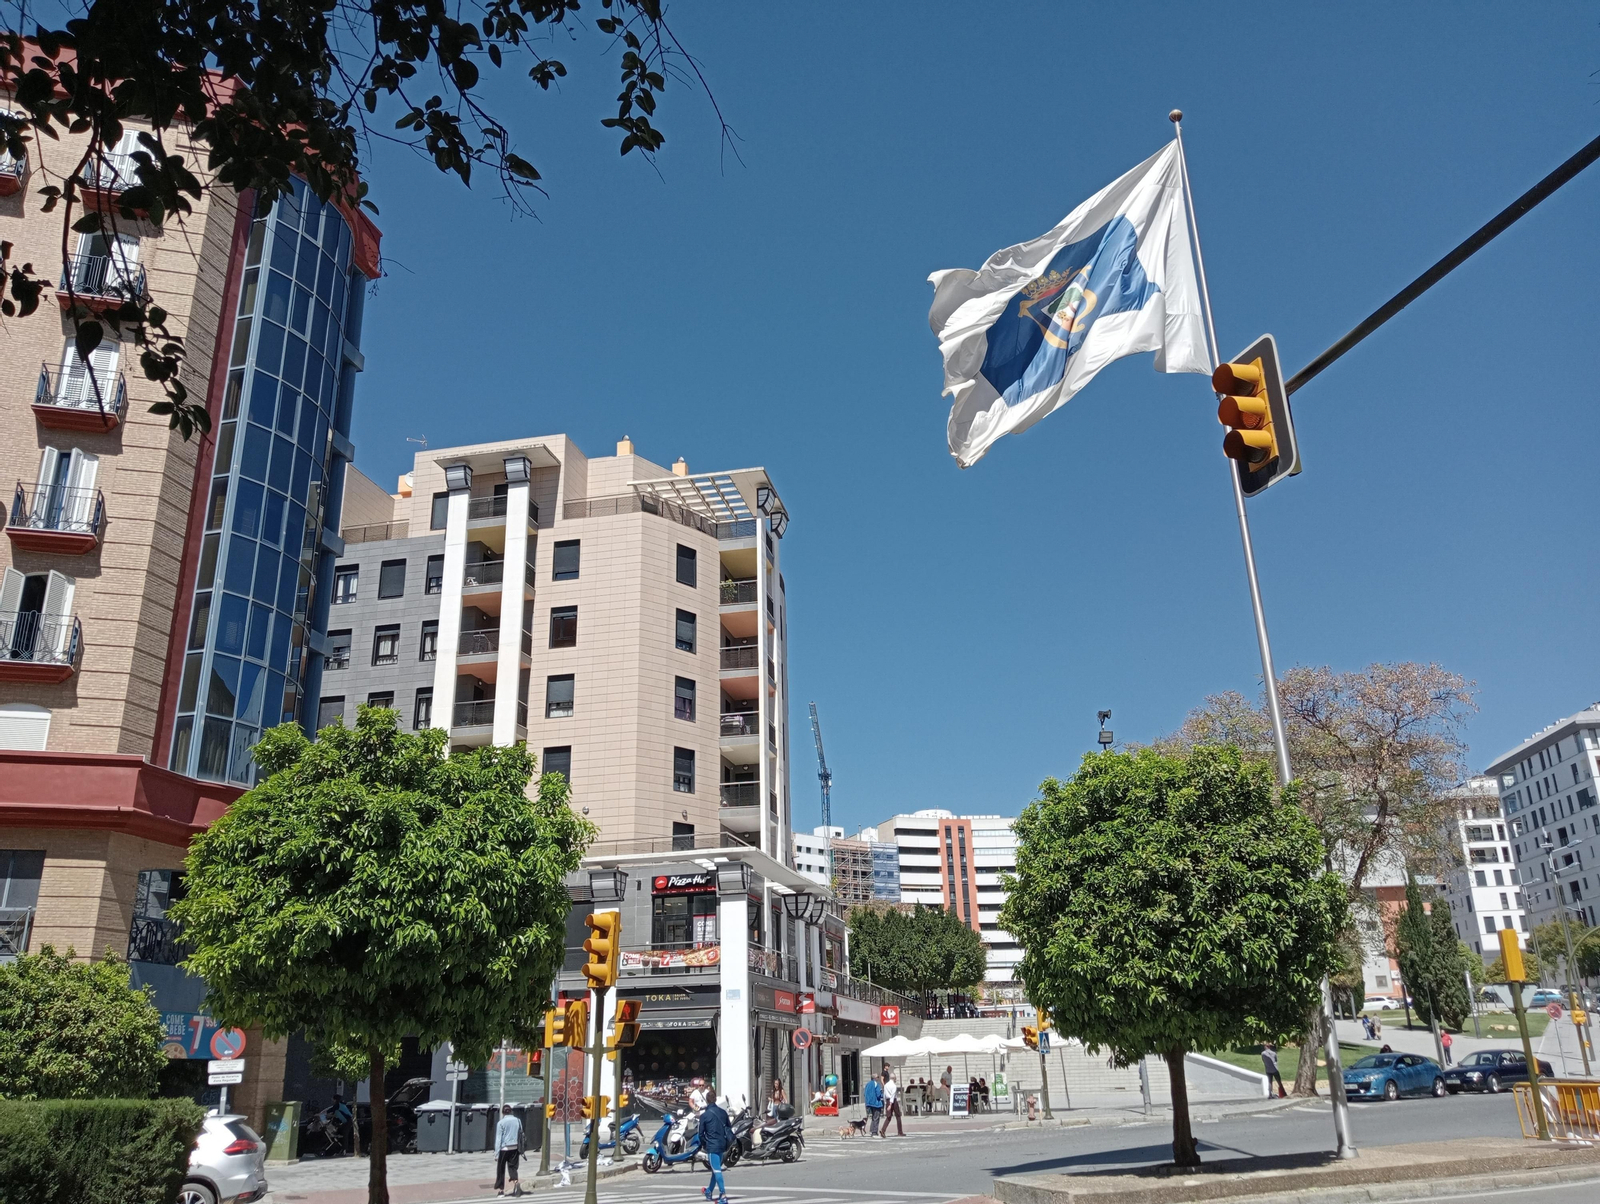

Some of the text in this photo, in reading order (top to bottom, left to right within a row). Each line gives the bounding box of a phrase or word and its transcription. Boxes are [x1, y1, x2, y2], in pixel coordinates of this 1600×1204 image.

[668, 876, 693, 888] Pizza
[645, 994, 671, 1002] TOKA
[166, 1014, 185, 1025] COME
[169, 1025, 186, 1036] BEBE
